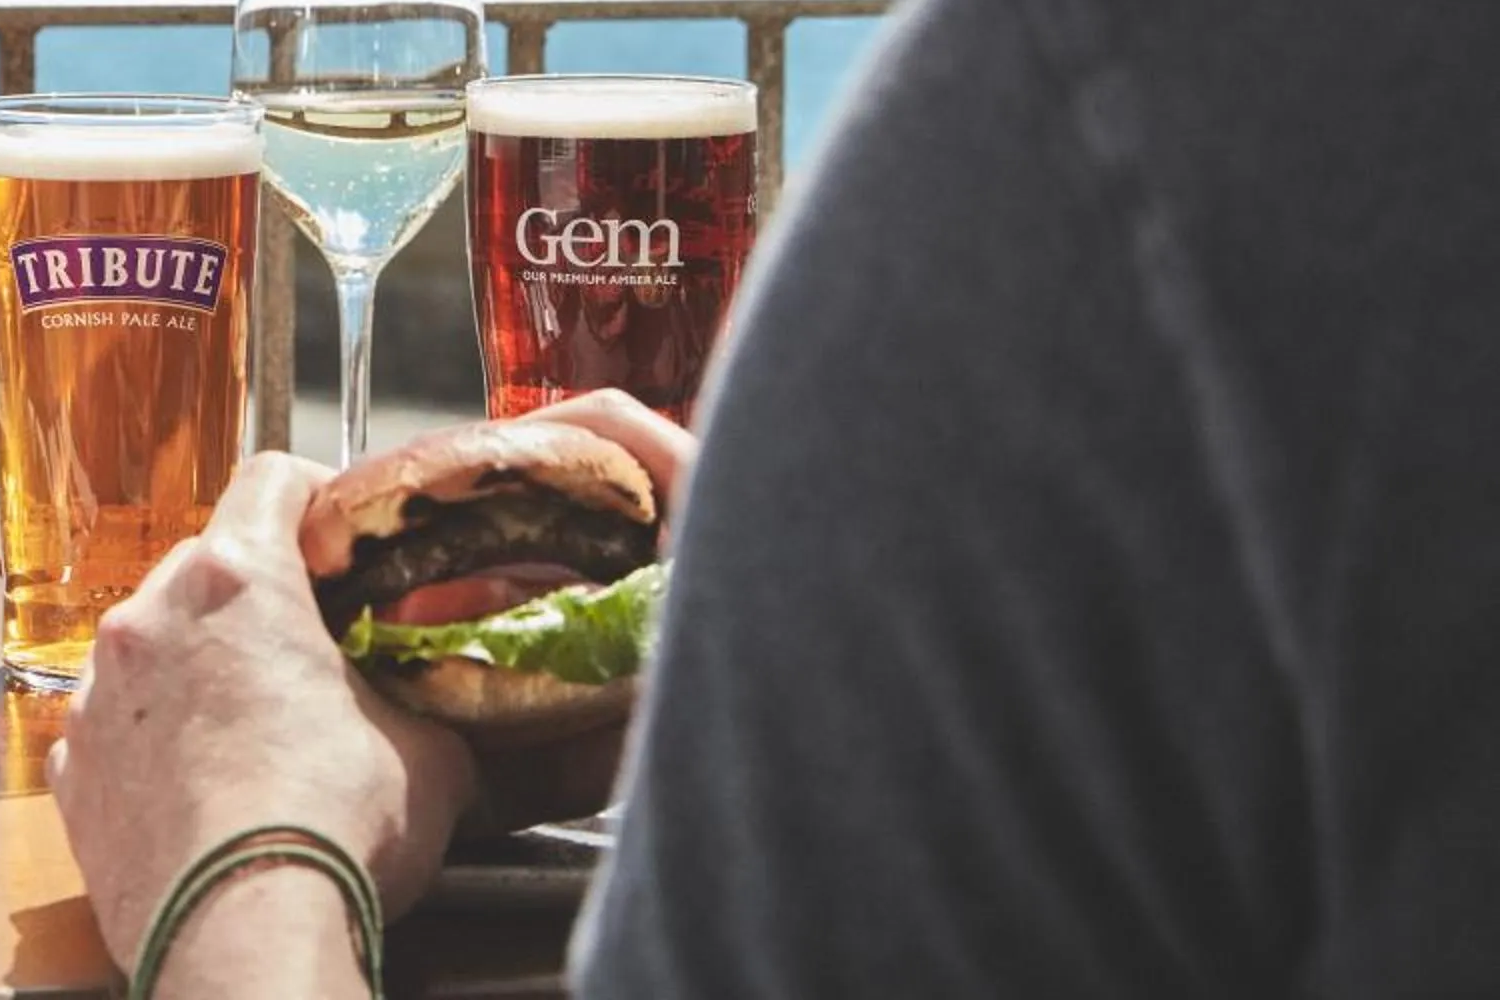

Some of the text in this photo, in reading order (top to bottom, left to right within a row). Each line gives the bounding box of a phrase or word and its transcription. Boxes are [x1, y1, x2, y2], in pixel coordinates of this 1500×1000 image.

[515, 207, 685, 267] Gem
[16, 246, 219, 295] TRIBUTE
[522, 270, 678, 286] OUR PREMIUM AMBER ALE
[41, 312, 197, 332] CORNISH PALE ALE
